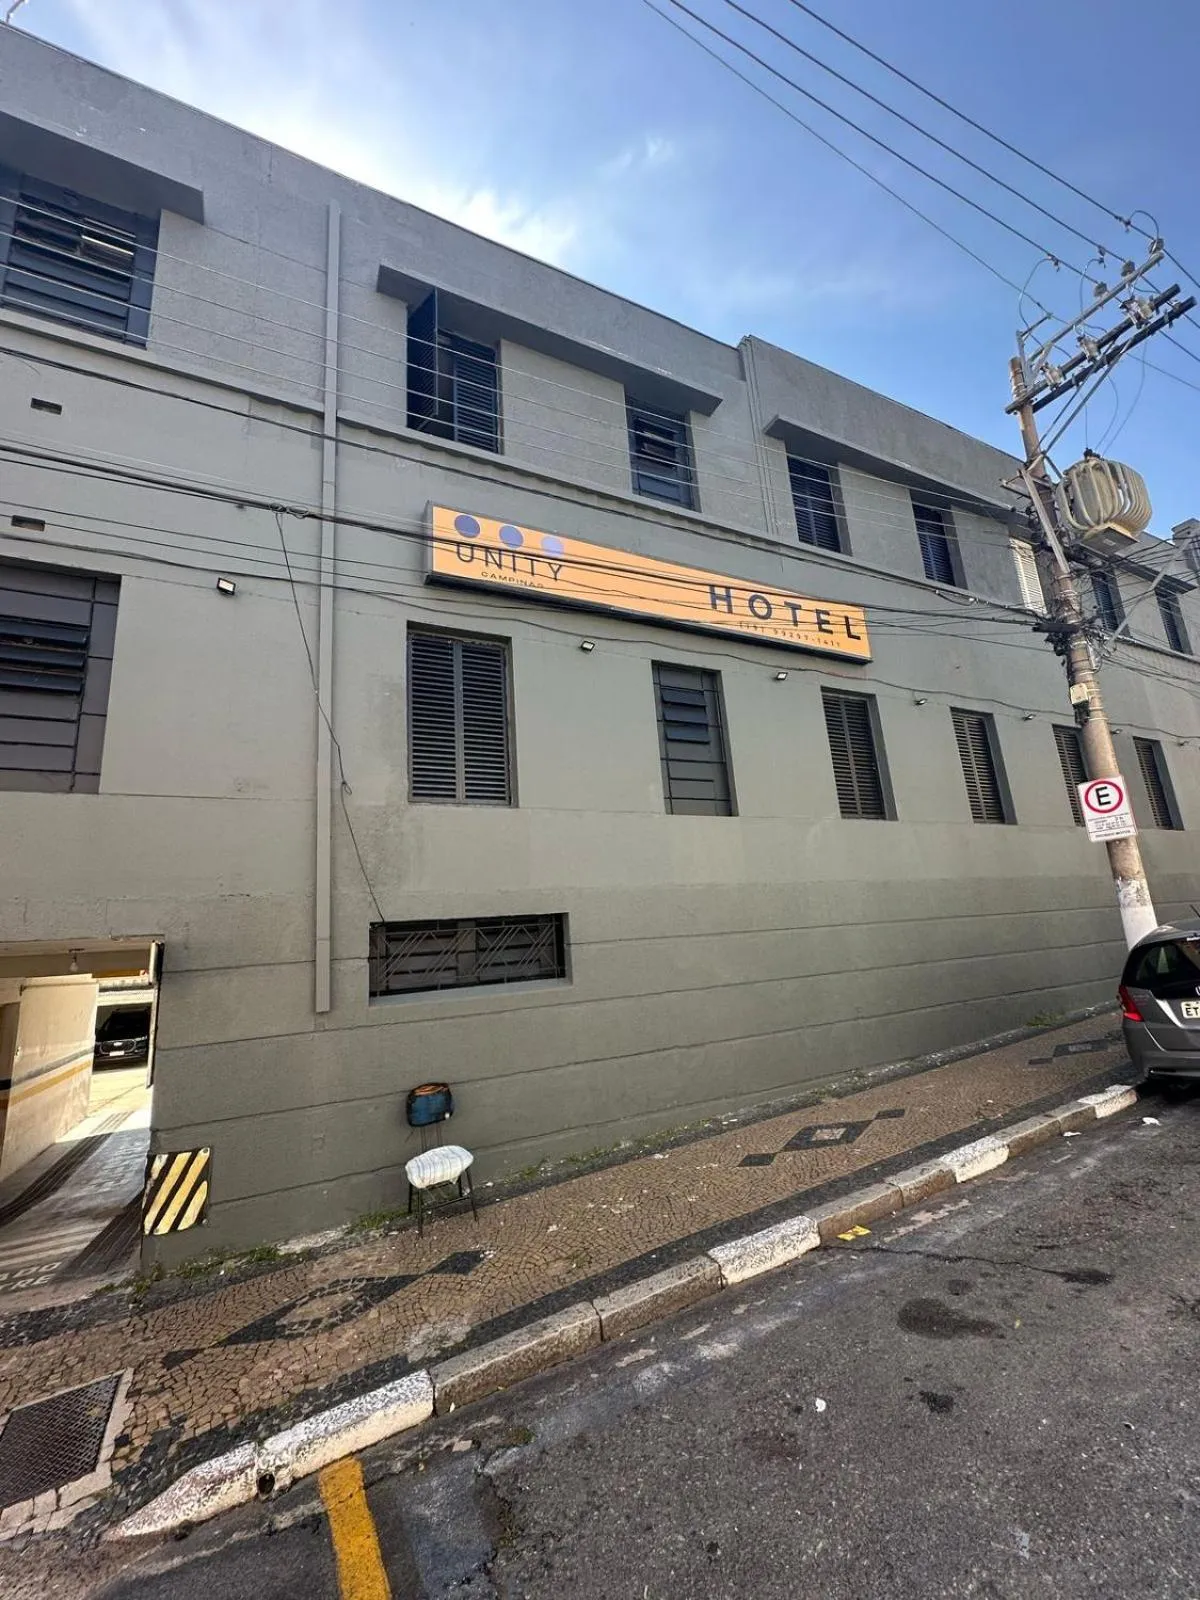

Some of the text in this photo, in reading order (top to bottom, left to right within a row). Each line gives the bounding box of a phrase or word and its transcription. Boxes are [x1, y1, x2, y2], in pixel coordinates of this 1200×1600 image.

[456, 542, 563, 581] UNITY
[481, 571, 544, 589] CAMPINAS
[709, 584, 861, 641] HOTEL
[1095, 786, 1112, 807] E
